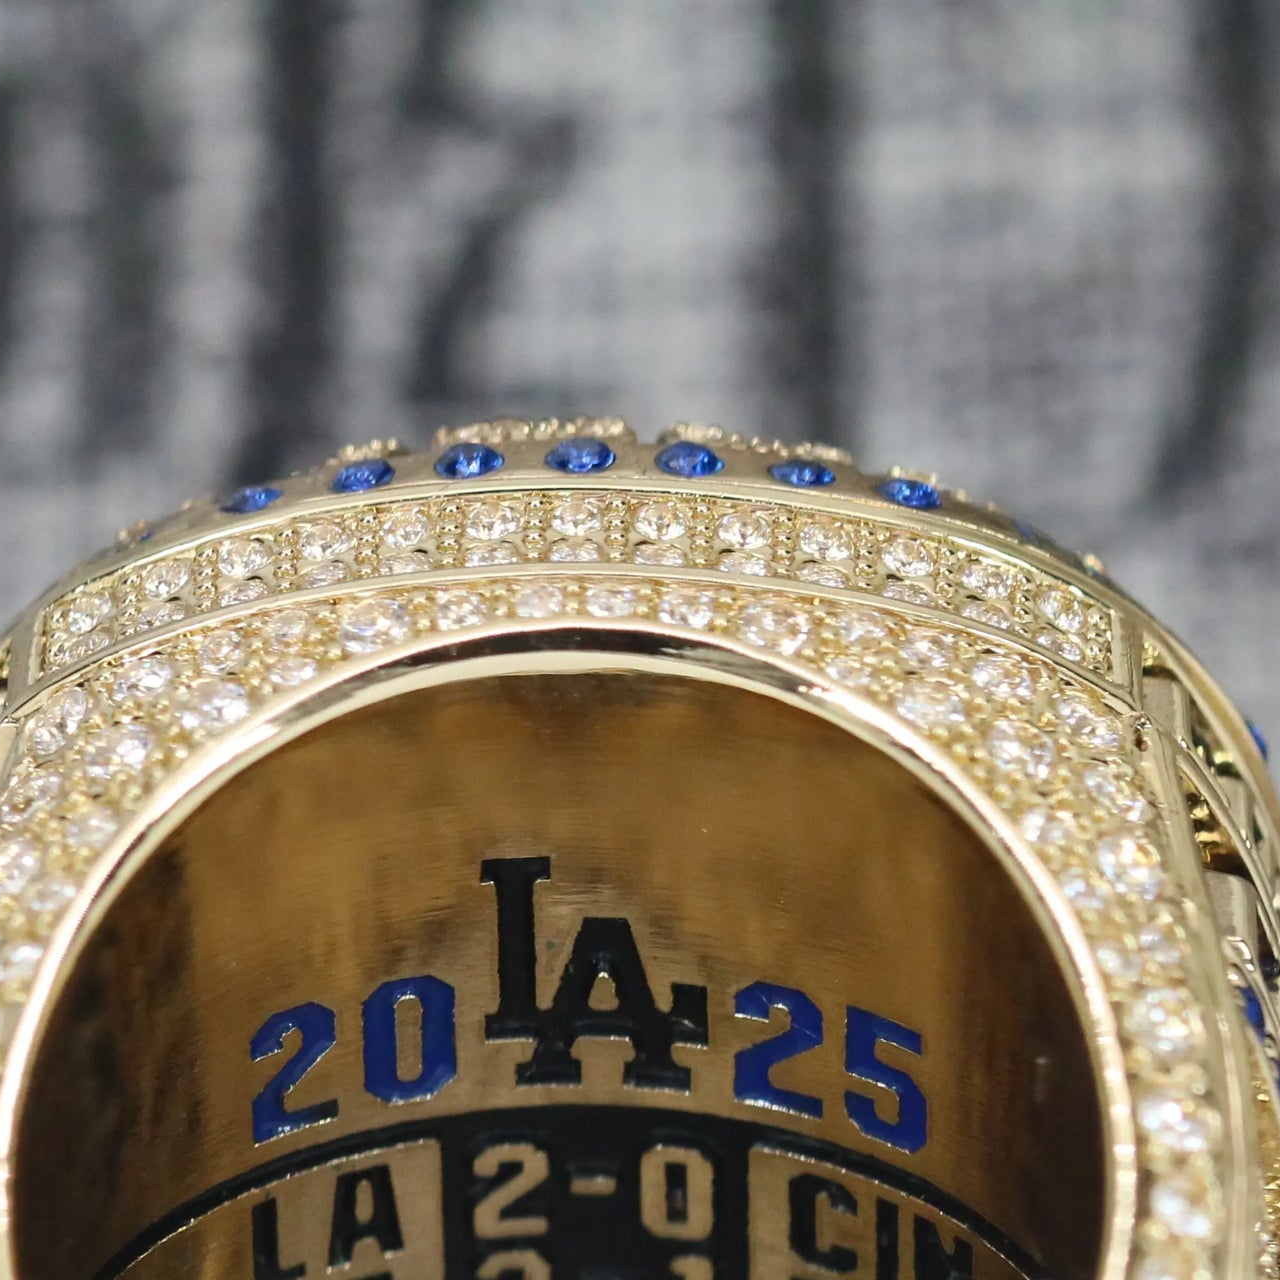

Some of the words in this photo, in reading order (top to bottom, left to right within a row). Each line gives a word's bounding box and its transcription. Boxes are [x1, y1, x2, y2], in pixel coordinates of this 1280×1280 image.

[249, 975, 458, 1148] 20
[480, 856, 709, 1094] LA
[734, 981, 928, 1154] 25
[473, 1143, 714, 1241] 2-0
